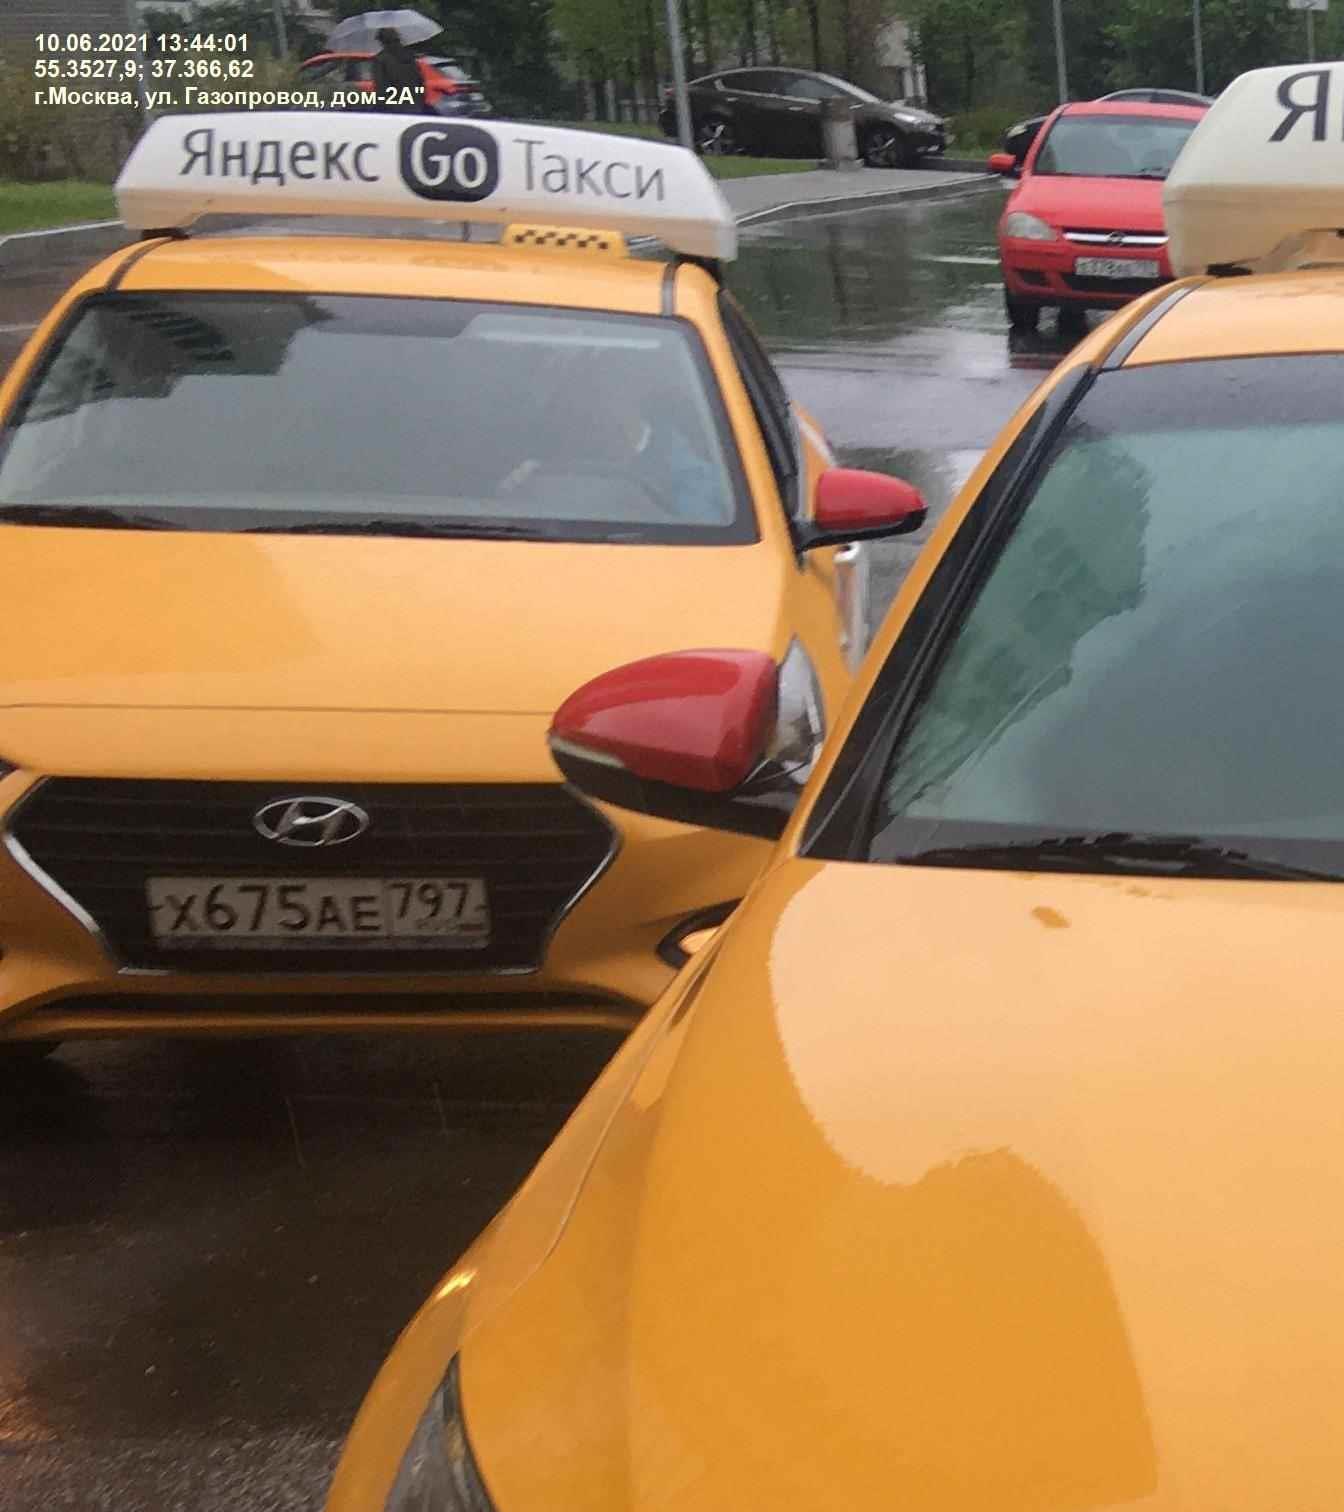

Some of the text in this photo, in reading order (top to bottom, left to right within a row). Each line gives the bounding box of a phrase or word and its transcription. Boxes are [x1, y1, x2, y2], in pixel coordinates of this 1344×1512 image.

[180, 127, 665, 202] Яндекс Go Такси
[386, 881, 471, 922] 797
